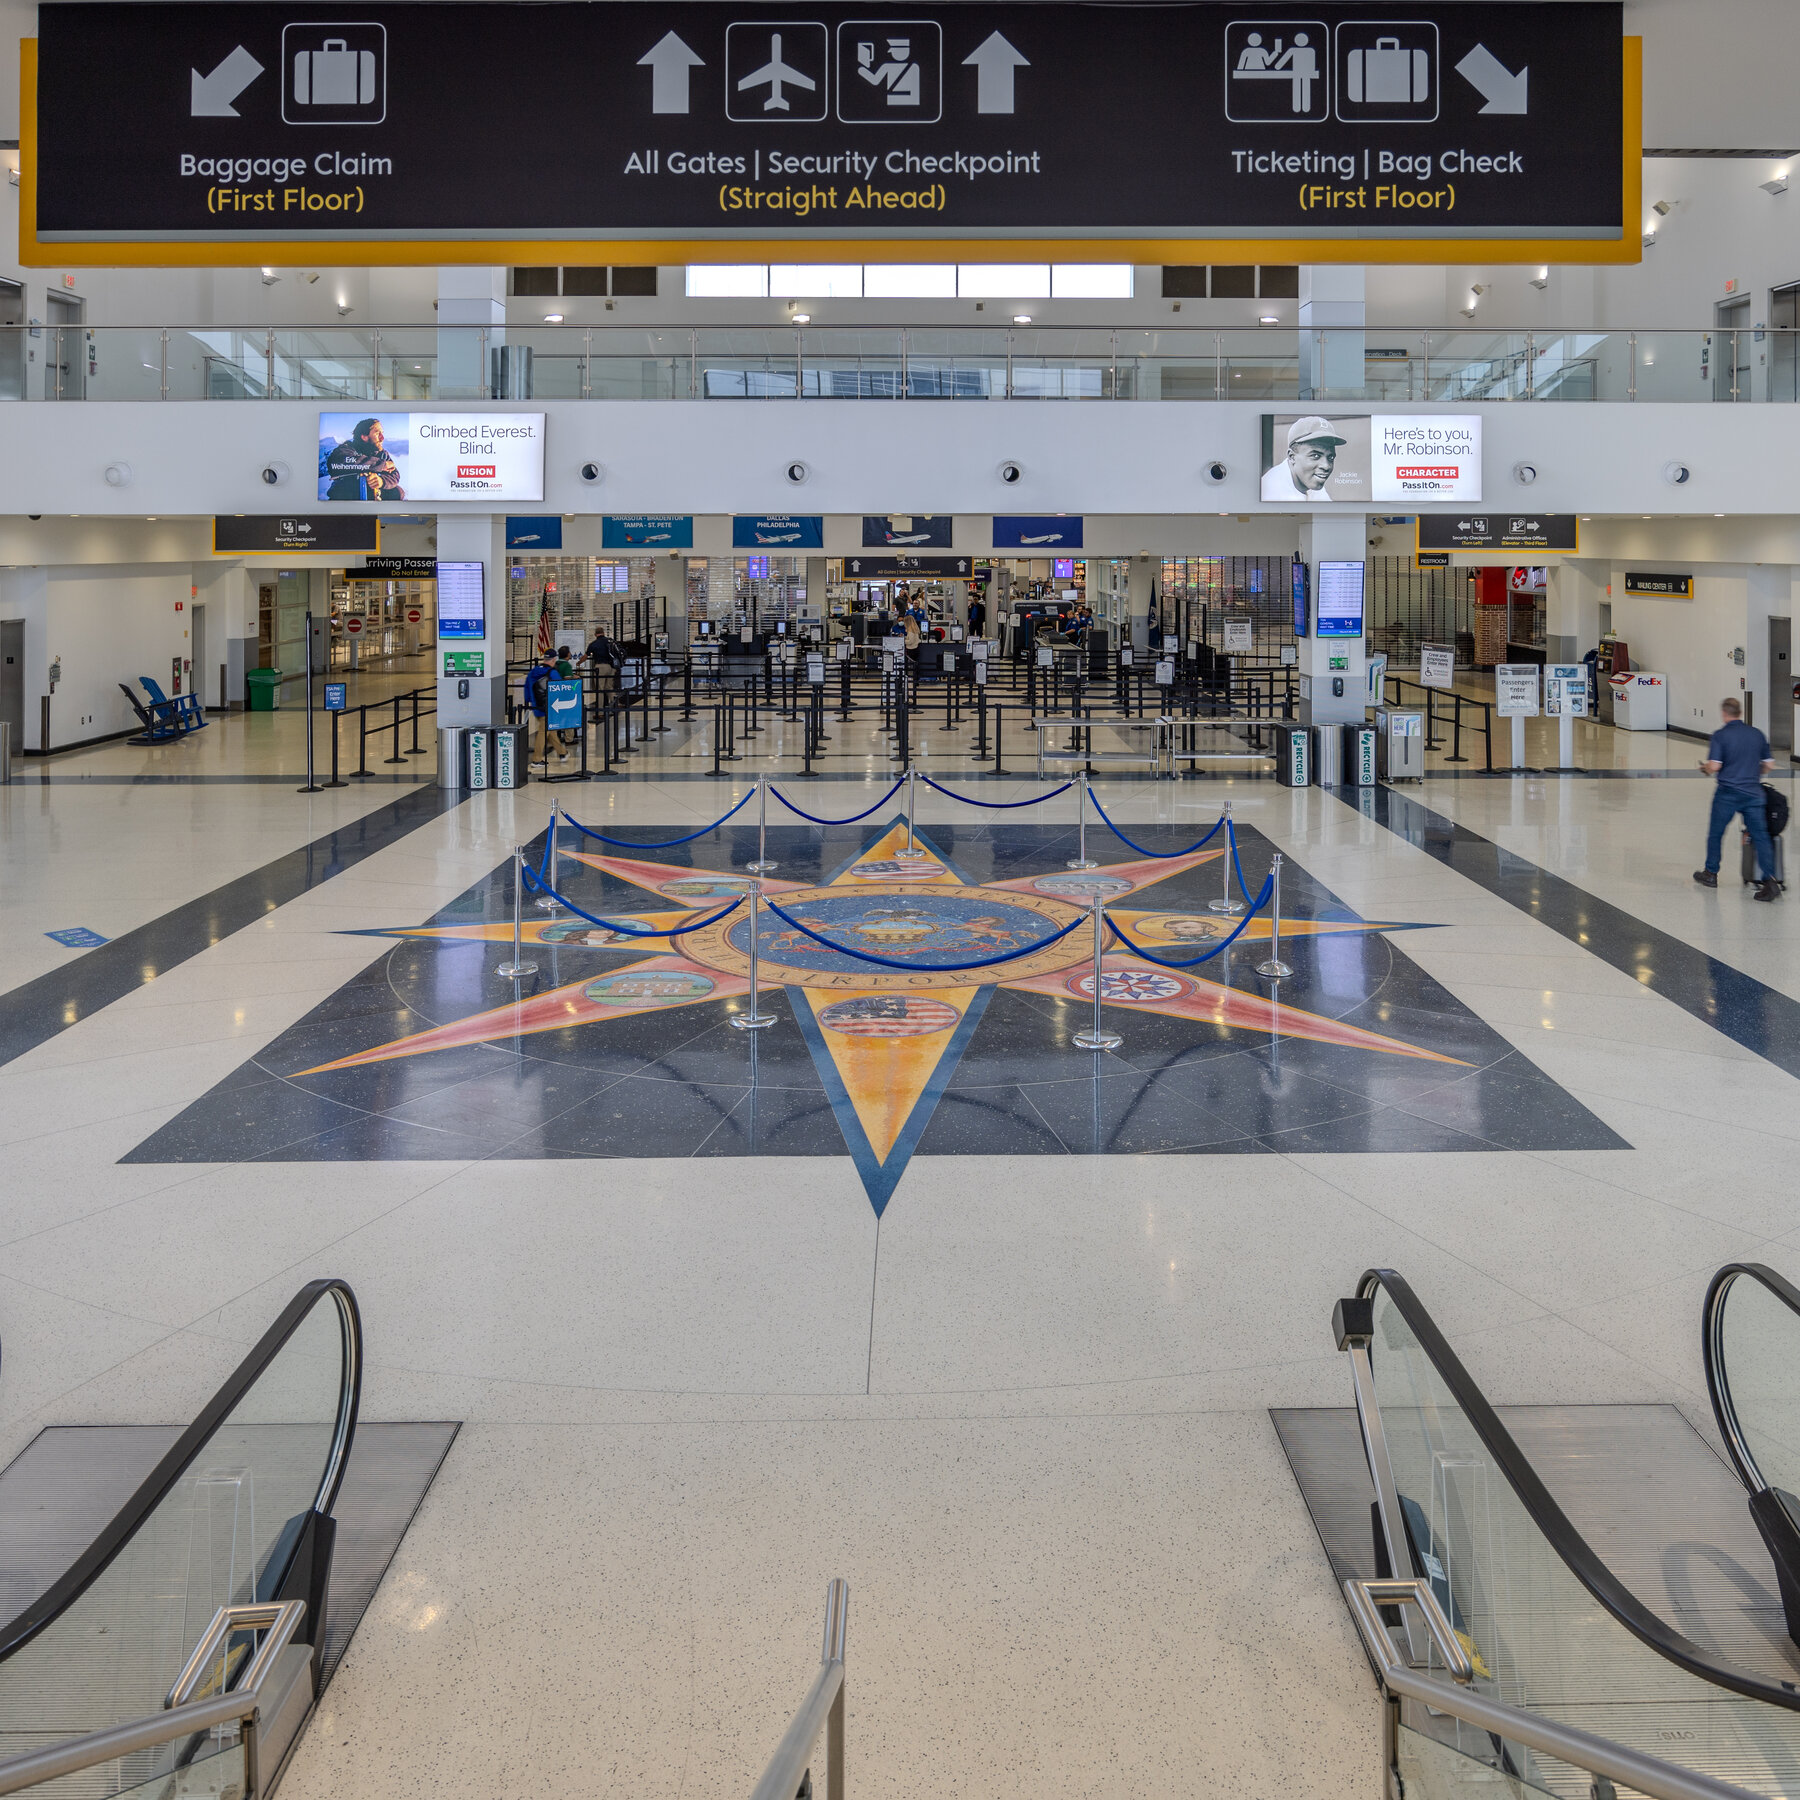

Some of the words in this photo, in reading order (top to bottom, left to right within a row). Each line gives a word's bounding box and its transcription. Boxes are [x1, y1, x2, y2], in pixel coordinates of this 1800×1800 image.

[180, 154, 307, 183] Baggage
[314, 151, 392, 176] Claim
[624, 150, 659, 174] All
[667, 151, 746, 174] Gates
[768, 150, 878, 181] Security
[885, 149, 1040, 180] Checkpoint
[1231, 150, 1355, 180] Ticketing
[1379, 151, 1431, 181] Bag
[1439, 149, 1523, 173] Check
[208, 186, 275, 214] (First
[284, 186, 364, 213] Floor)
[719, 184, 838, 216] (Straight
[845, 184, 946, 211] Ahead)
[1299, 183, 1366, 211] (First
[1375, 183, 1455, 211] Floor)
[420, 425, 477, 438] Climbed
[481, 425, 536, 438] Everest.
[1384, 427, 1425, 440] Here's
[1428, 428, 1442, 440] to
[1445, 430, 1473, 442] you,
[460, 441, 496, 454] Blind.
[1384, 442, 1404, 455] Mr.
[1407, 442, 1473, 455] Robinson.
[549, 684, 560, 692] TSA
[1616, 692, 1627, 701] FedEx
[474, 749, 482, 776] RECYCLE
[1363, 746, 1371, 773] RECYCLE
